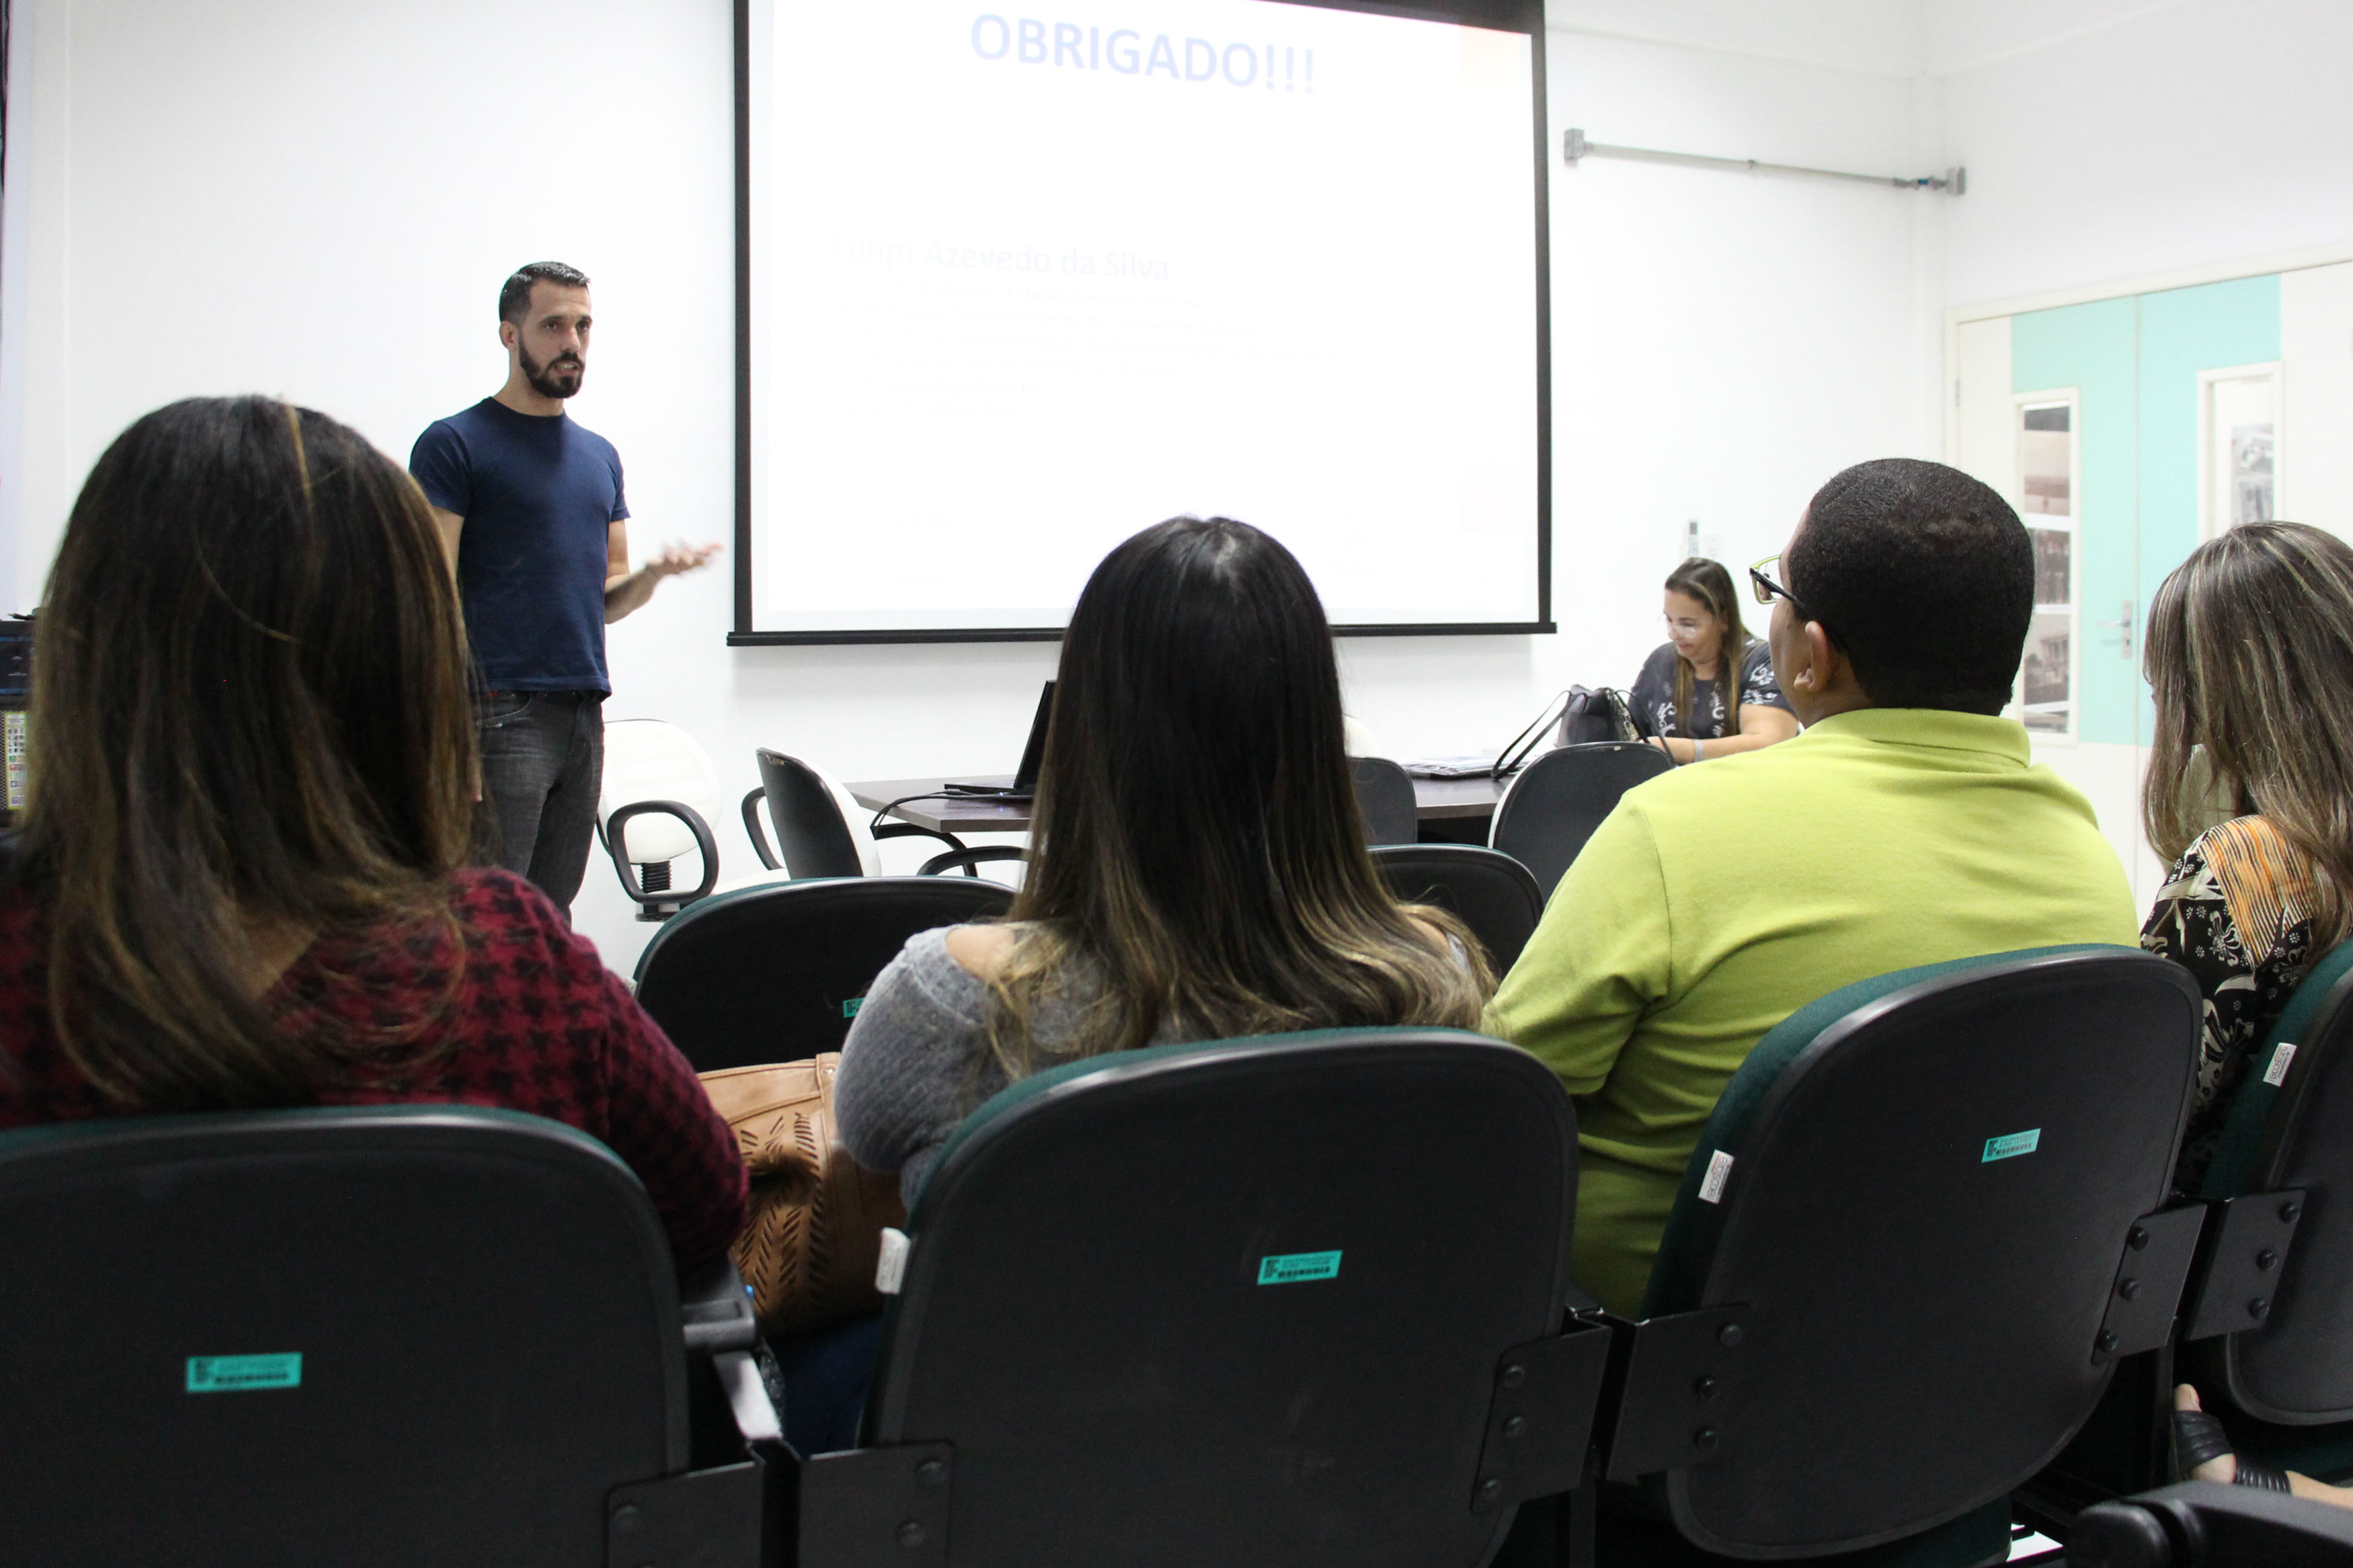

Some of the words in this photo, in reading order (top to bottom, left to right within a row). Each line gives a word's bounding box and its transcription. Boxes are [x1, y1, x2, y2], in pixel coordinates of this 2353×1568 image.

[971, 13, 1314, 94] OBRIGADO!!!
[926, 241, 1051, 272] Azevedo
[1061, 247, 1095, 275] da
[1105, 251, 1169, 280] Silva
